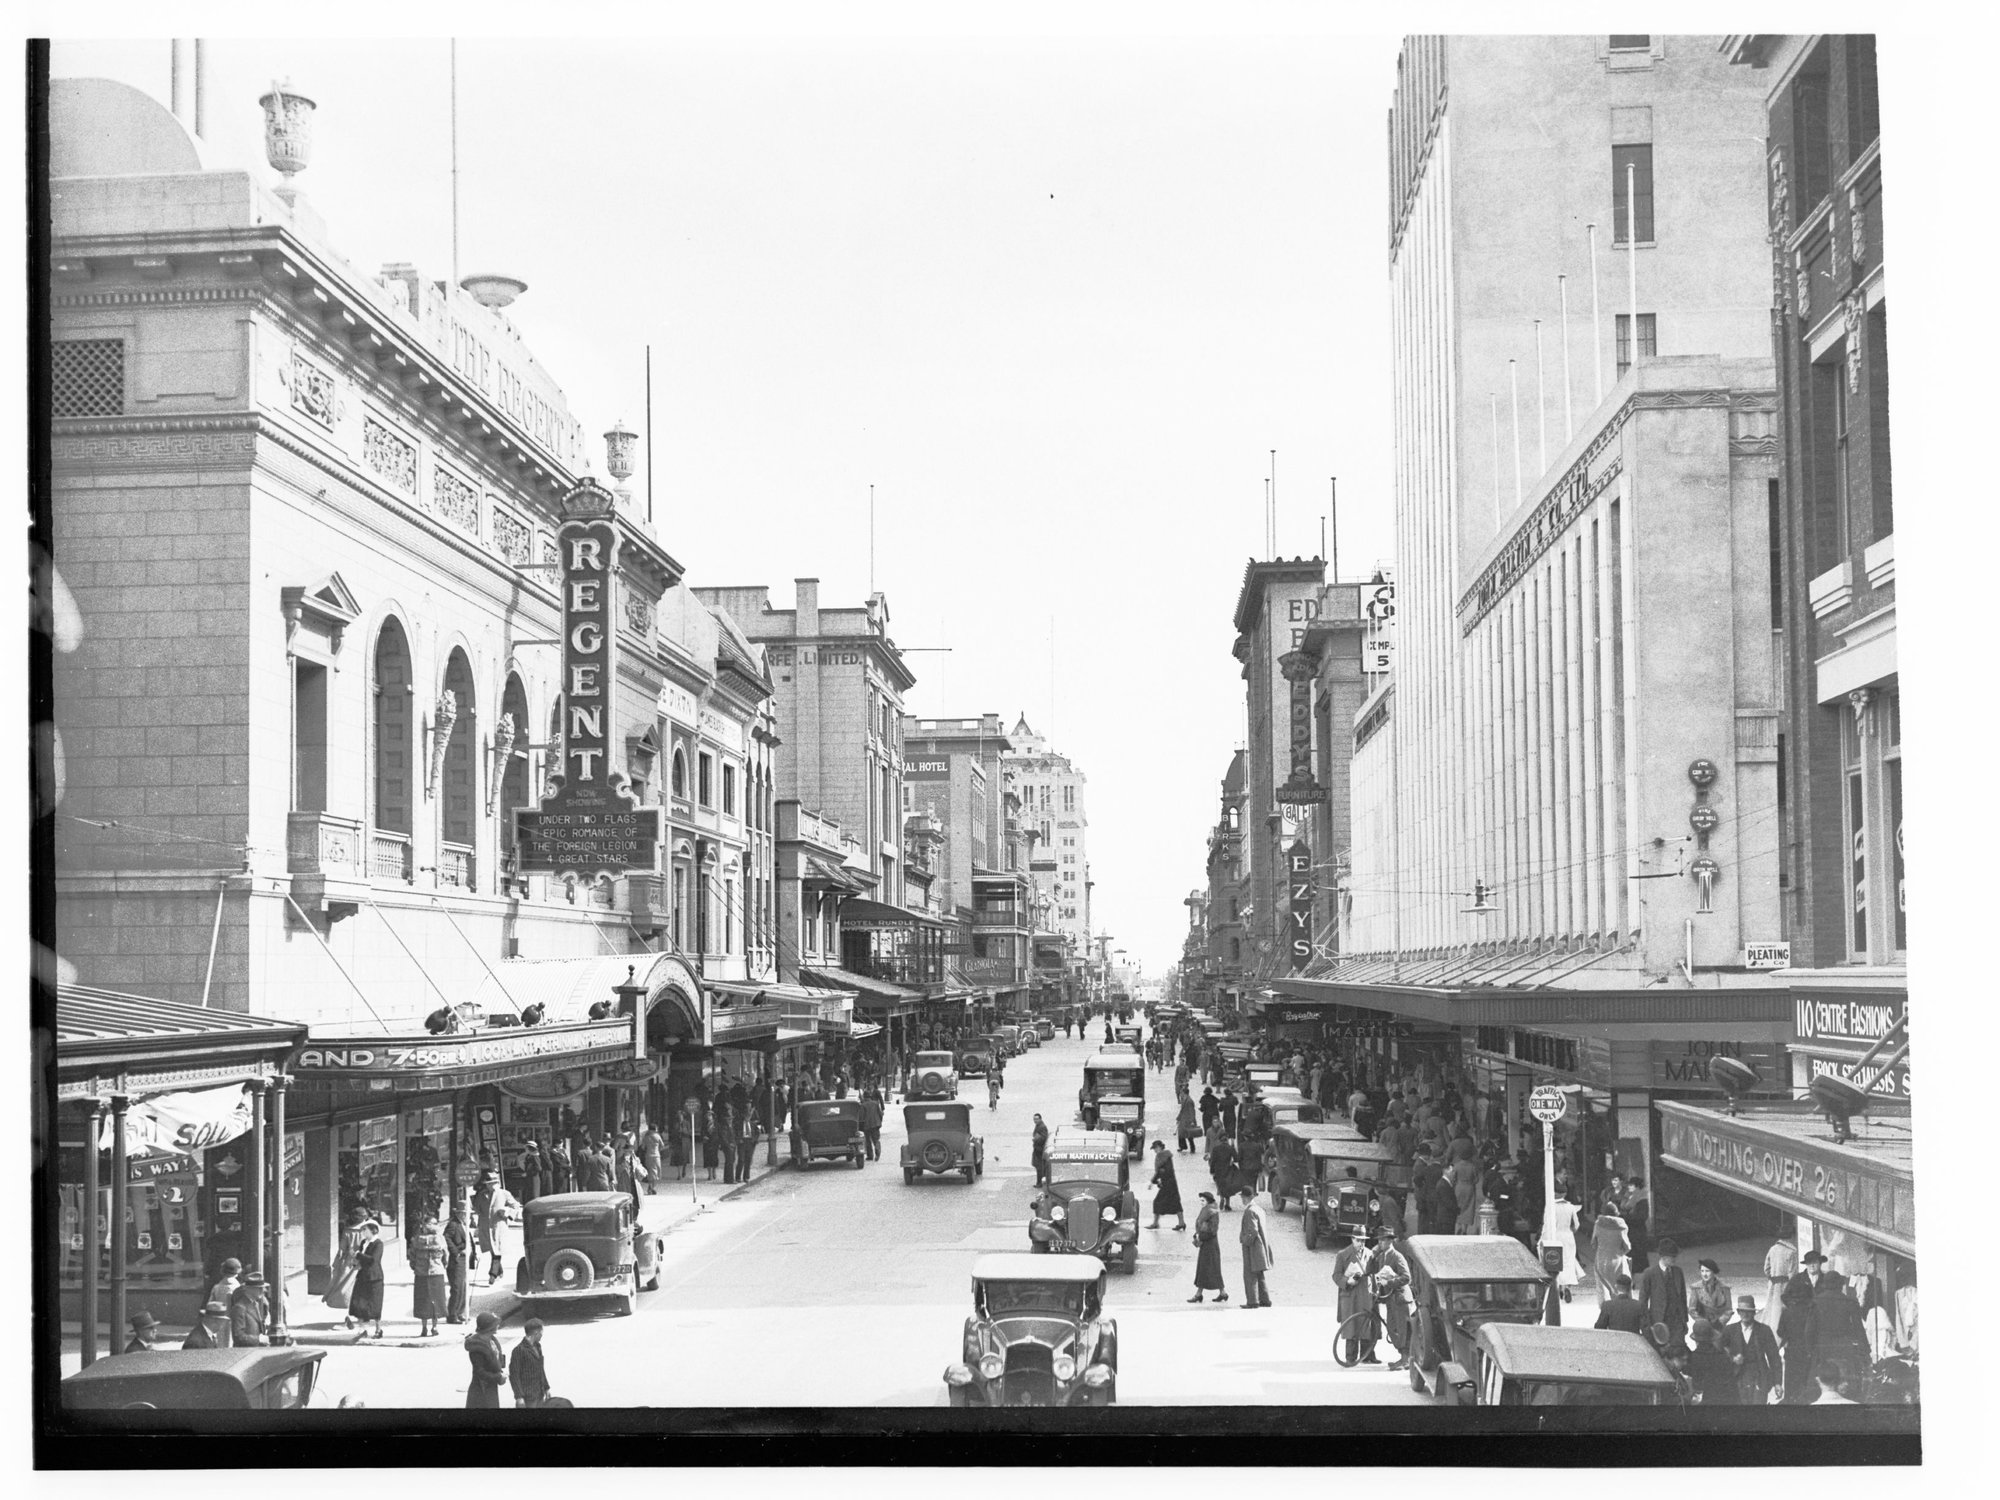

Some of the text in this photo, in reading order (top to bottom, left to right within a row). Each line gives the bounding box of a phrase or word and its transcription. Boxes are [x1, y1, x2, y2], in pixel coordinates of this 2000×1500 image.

[452, 316, 563, 460] THE REGENT
[570, 538, 604, 782] REGENT
[1293, 680, 1310, 782] EDDYS
[919, 761, 949, 773] HOTEL
[575, 790, 597, 798] NOW
[1278, 790, 1325, 800] FURNITURE
[566, 799, 606, 807] SHOWING
[539, 815, 637, 825] UNDER TWO FLAGS
[543, 828, 638, 838] EPIC ROMANCE OF
[532, 841, 637, 851] THE FOREIGN LEGION
[559, 855, 590, 864] GREAT
[597, 854, 629, 864] STARS
[1291, 855, 1310, 956] EZYS
[1747, 948, 1790, 960] PLEATING
[1815, 1000, 1848, 1035] CENTRE
[1850, 1001, 1894, 1038] FASHIONS
[300, 1050, 375, 1067] AND
[1535, 1088, 1560, 1098] TRAFFIC
[1531, 1100, 1561, 1109] ONE WAY
[1539, 1112, 1556, 1120] ONLY
[1050, 1152, 1068, 1160] JOHN
[1070, 1152, 1095, 1160] MARTIN
[1693, 1132, 1836, 1204] NOTHING OVER 2/6
